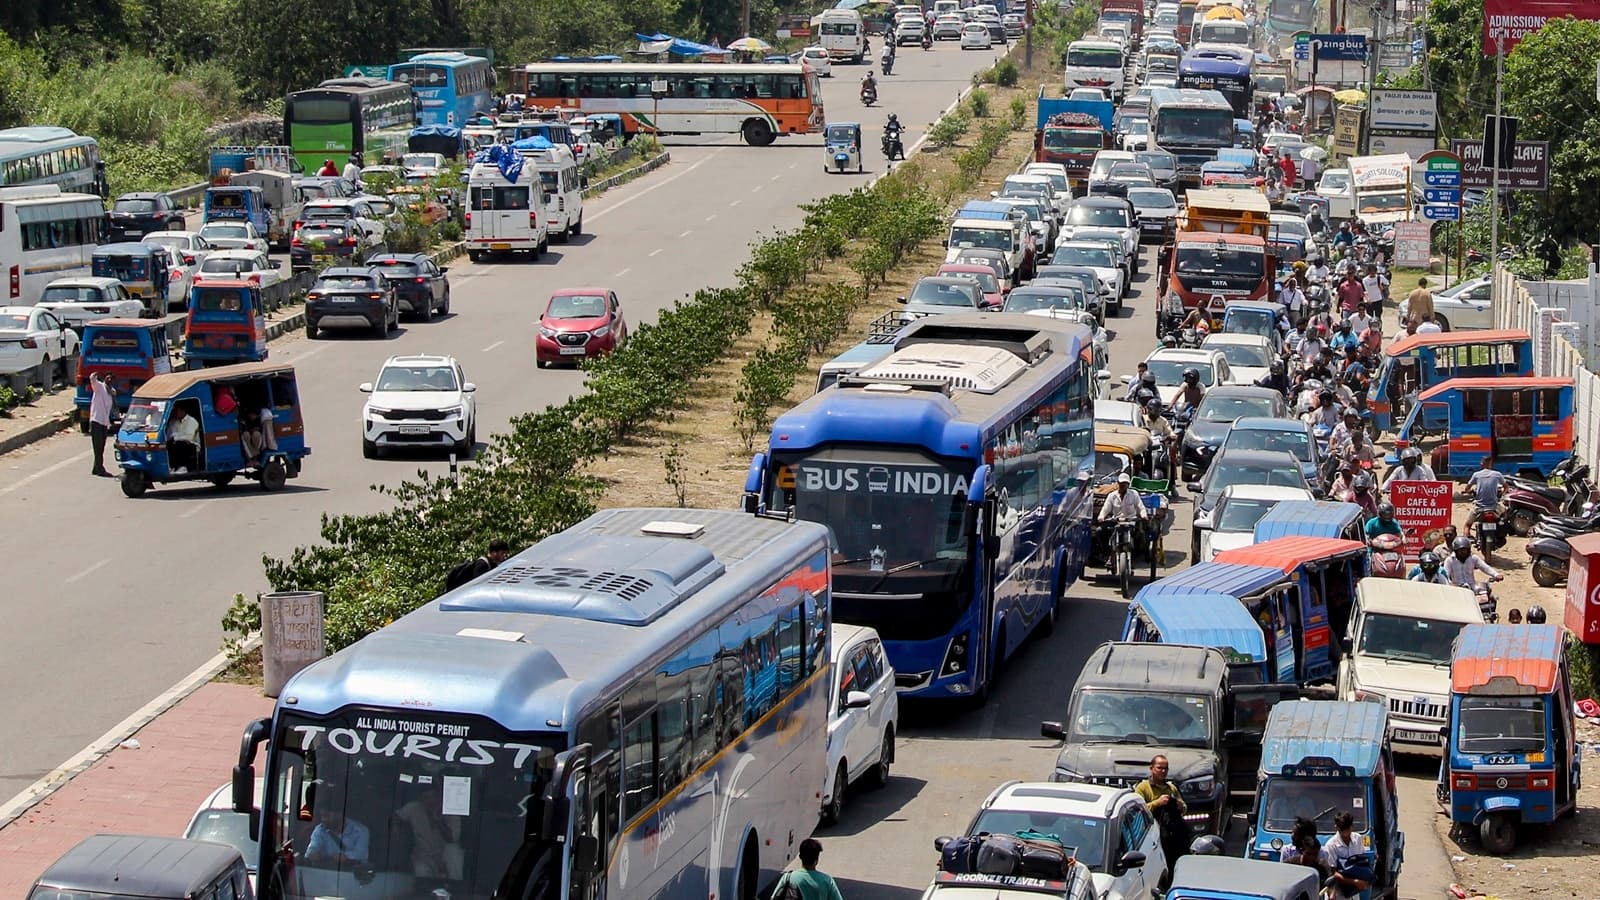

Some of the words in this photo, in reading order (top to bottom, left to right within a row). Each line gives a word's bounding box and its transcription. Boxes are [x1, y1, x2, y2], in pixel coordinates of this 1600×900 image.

[1489, 16, 1547, 28] ADMISSIONS
[1489, 28, 1509, 39] OPN
[1323, 41, 1364, 50] zingbus
[1183, 75, 1214, 85] zingbus
[802, 466, 859, 491] BUS
[895, 471, 969, 495] INDIA
[1407, 498, 1428, 507] CAFE
[1430, 498, 1436, 507] &
[1396, 508, 1447, 516] RESTAURANT
[356, 717, 371, 729] ALL
[374, 719, 397, 731] INDIA
[398, 720, 436, 734] TOURIST
[437, 723, 470, 737] PERMIT
[294, 725, 542, 768] TOURIST
[1004, 875, 1046, 887] TRAVELS
